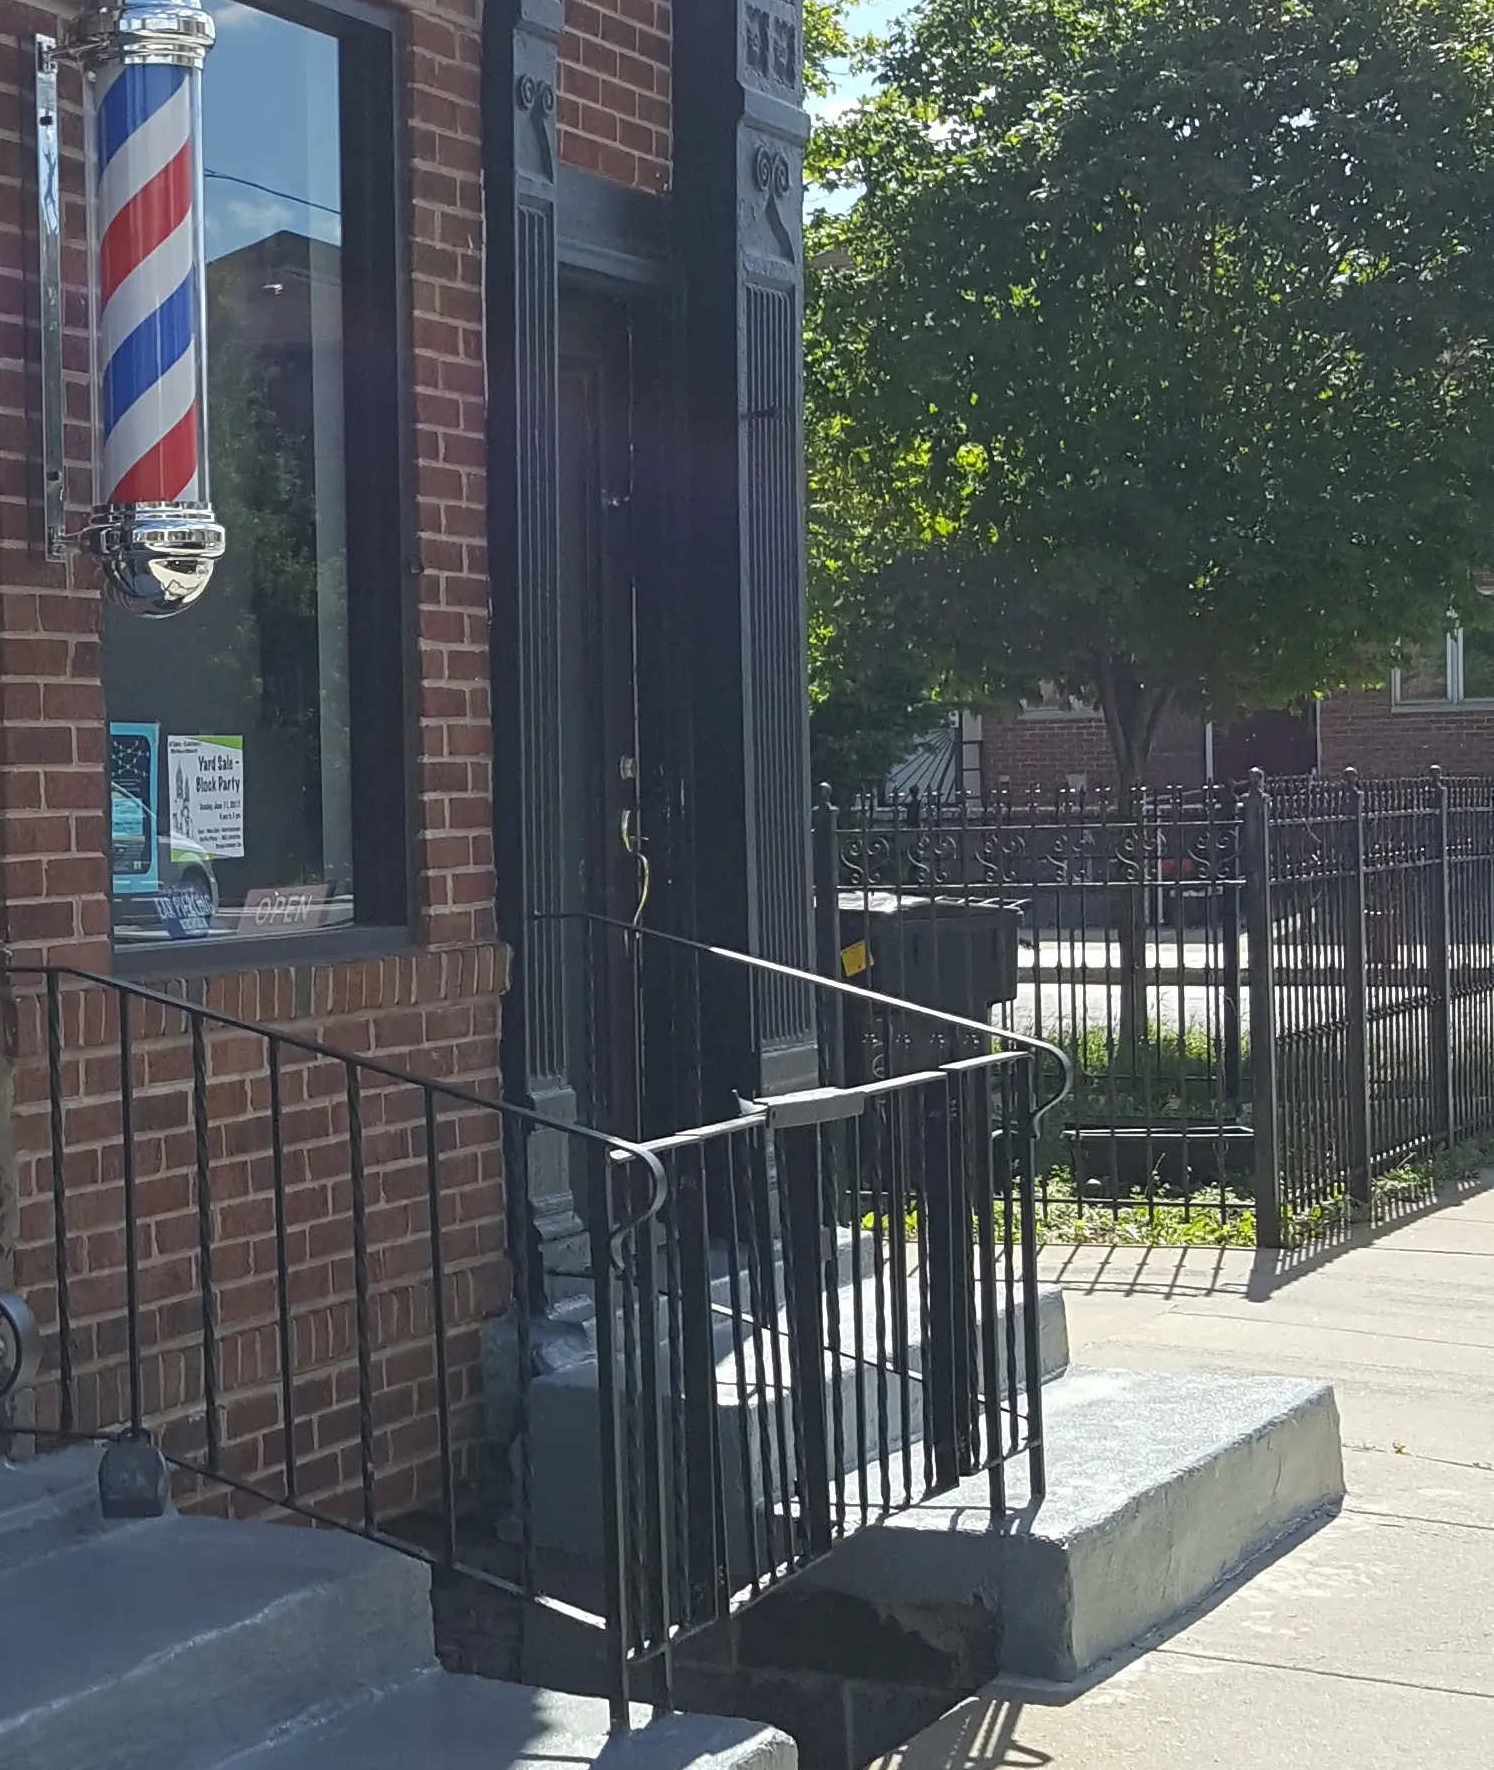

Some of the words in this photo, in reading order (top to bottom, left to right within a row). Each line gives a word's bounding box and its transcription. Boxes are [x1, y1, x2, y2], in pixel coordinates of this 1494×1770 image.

[198, 755, 216, 772] Yard
[217, 755, 234, 771] Sale
[196, 776, 217, 793] Block
[218, 776, 241, 794] Party
[255, 892, 314, 927] OPEN
